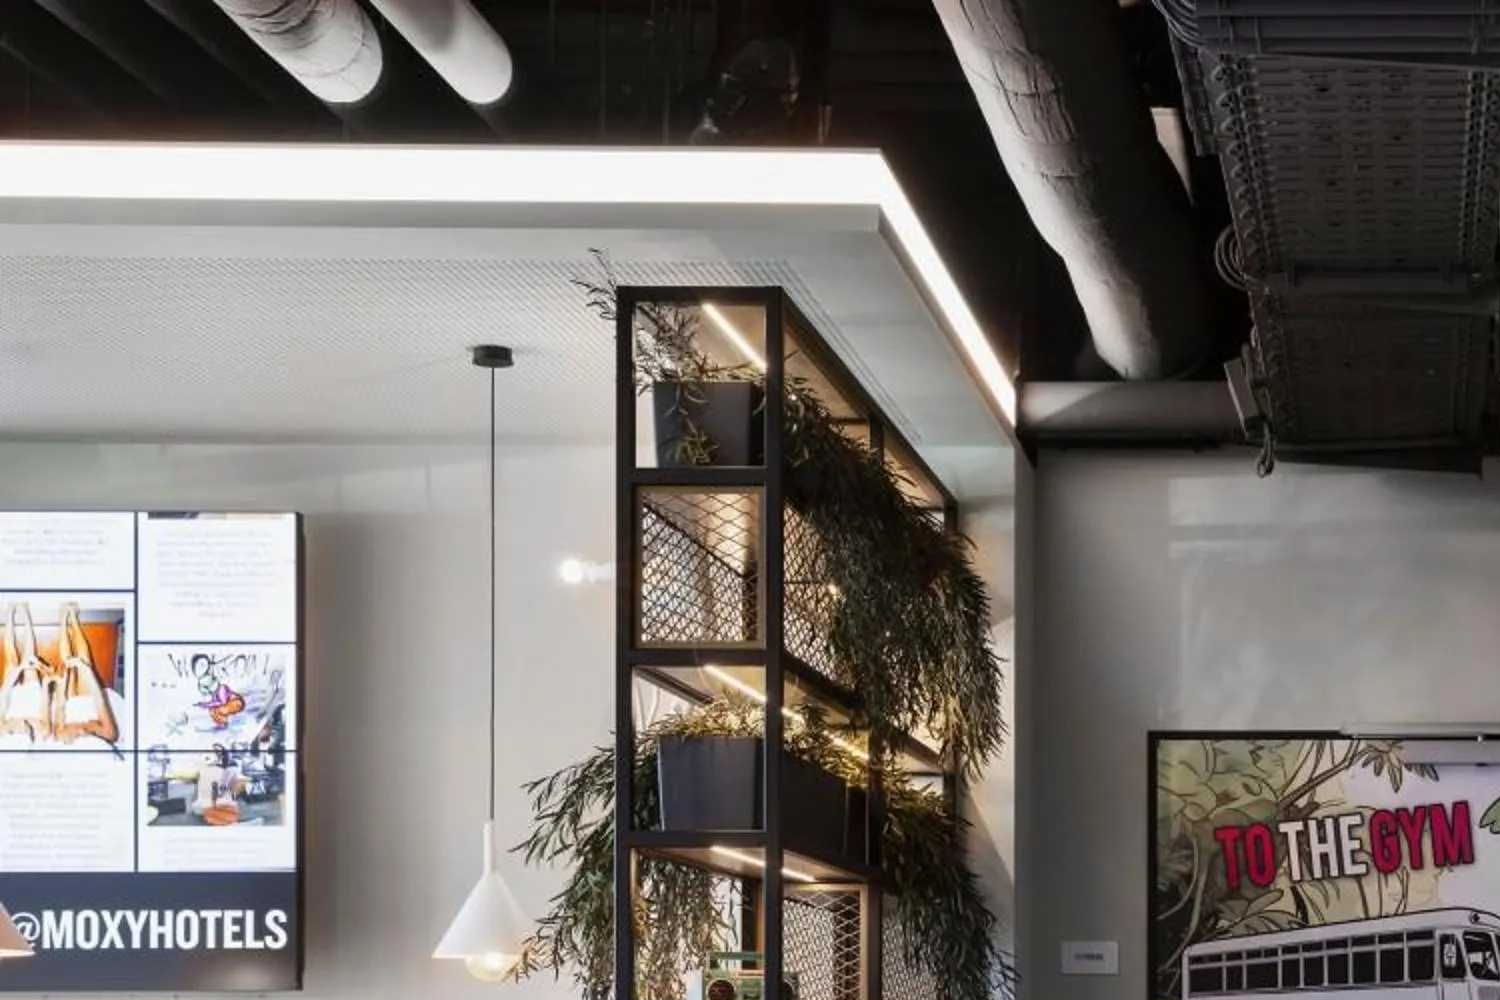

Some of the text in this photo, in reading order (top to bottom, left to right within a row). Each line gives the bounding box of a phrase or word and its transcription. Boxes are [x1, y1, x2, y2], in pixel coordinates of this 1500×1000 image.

[1214, 800, 1475, 891] TO THE GYM
[10, 909, 288, 950] @MOXYHOTELS
